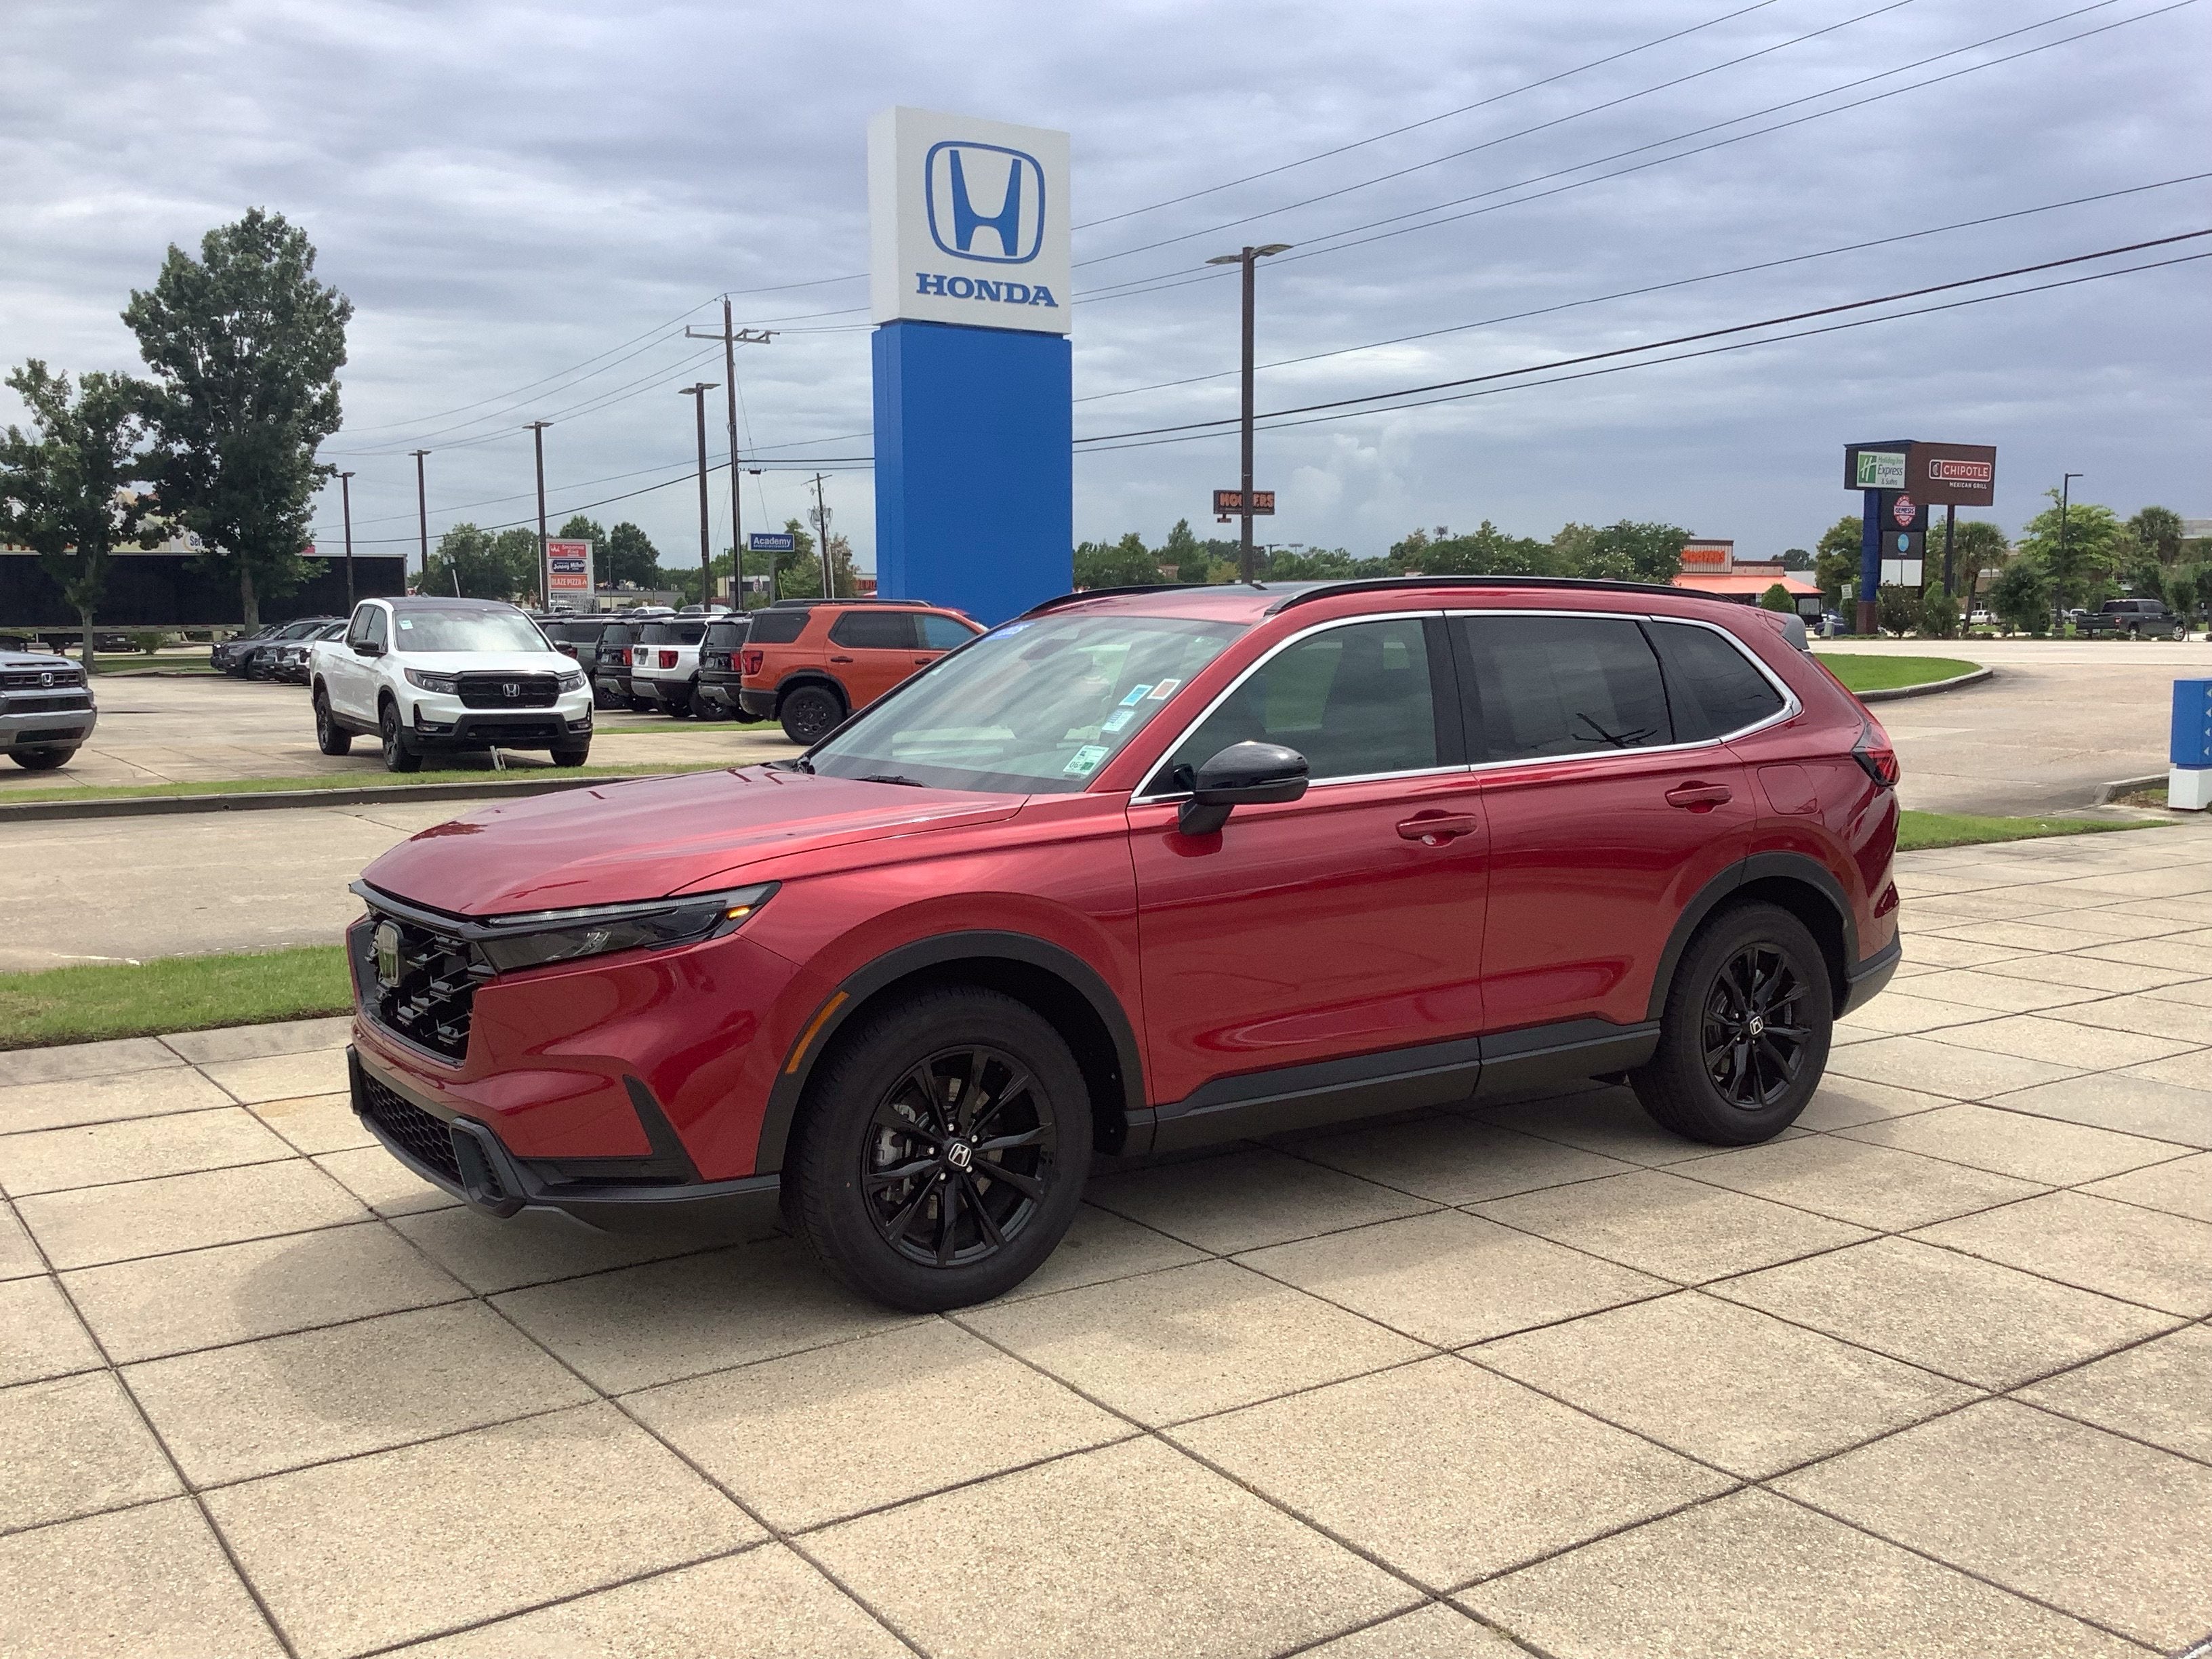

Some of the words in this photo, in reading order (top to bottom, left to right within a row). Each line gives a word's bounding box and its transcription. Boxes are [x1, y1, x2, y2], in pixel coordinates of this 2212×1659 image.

[916, 272, 1059, 308] HONDA
[1878, 464, 1903, 477] Express
[1943, 464, 1989, 477] CHIPOTLE
[1220, 493, 1273, 507] HOERS
[753, 536, 792, 548] Academy
[567, 578, 582, 586] PIZZA
